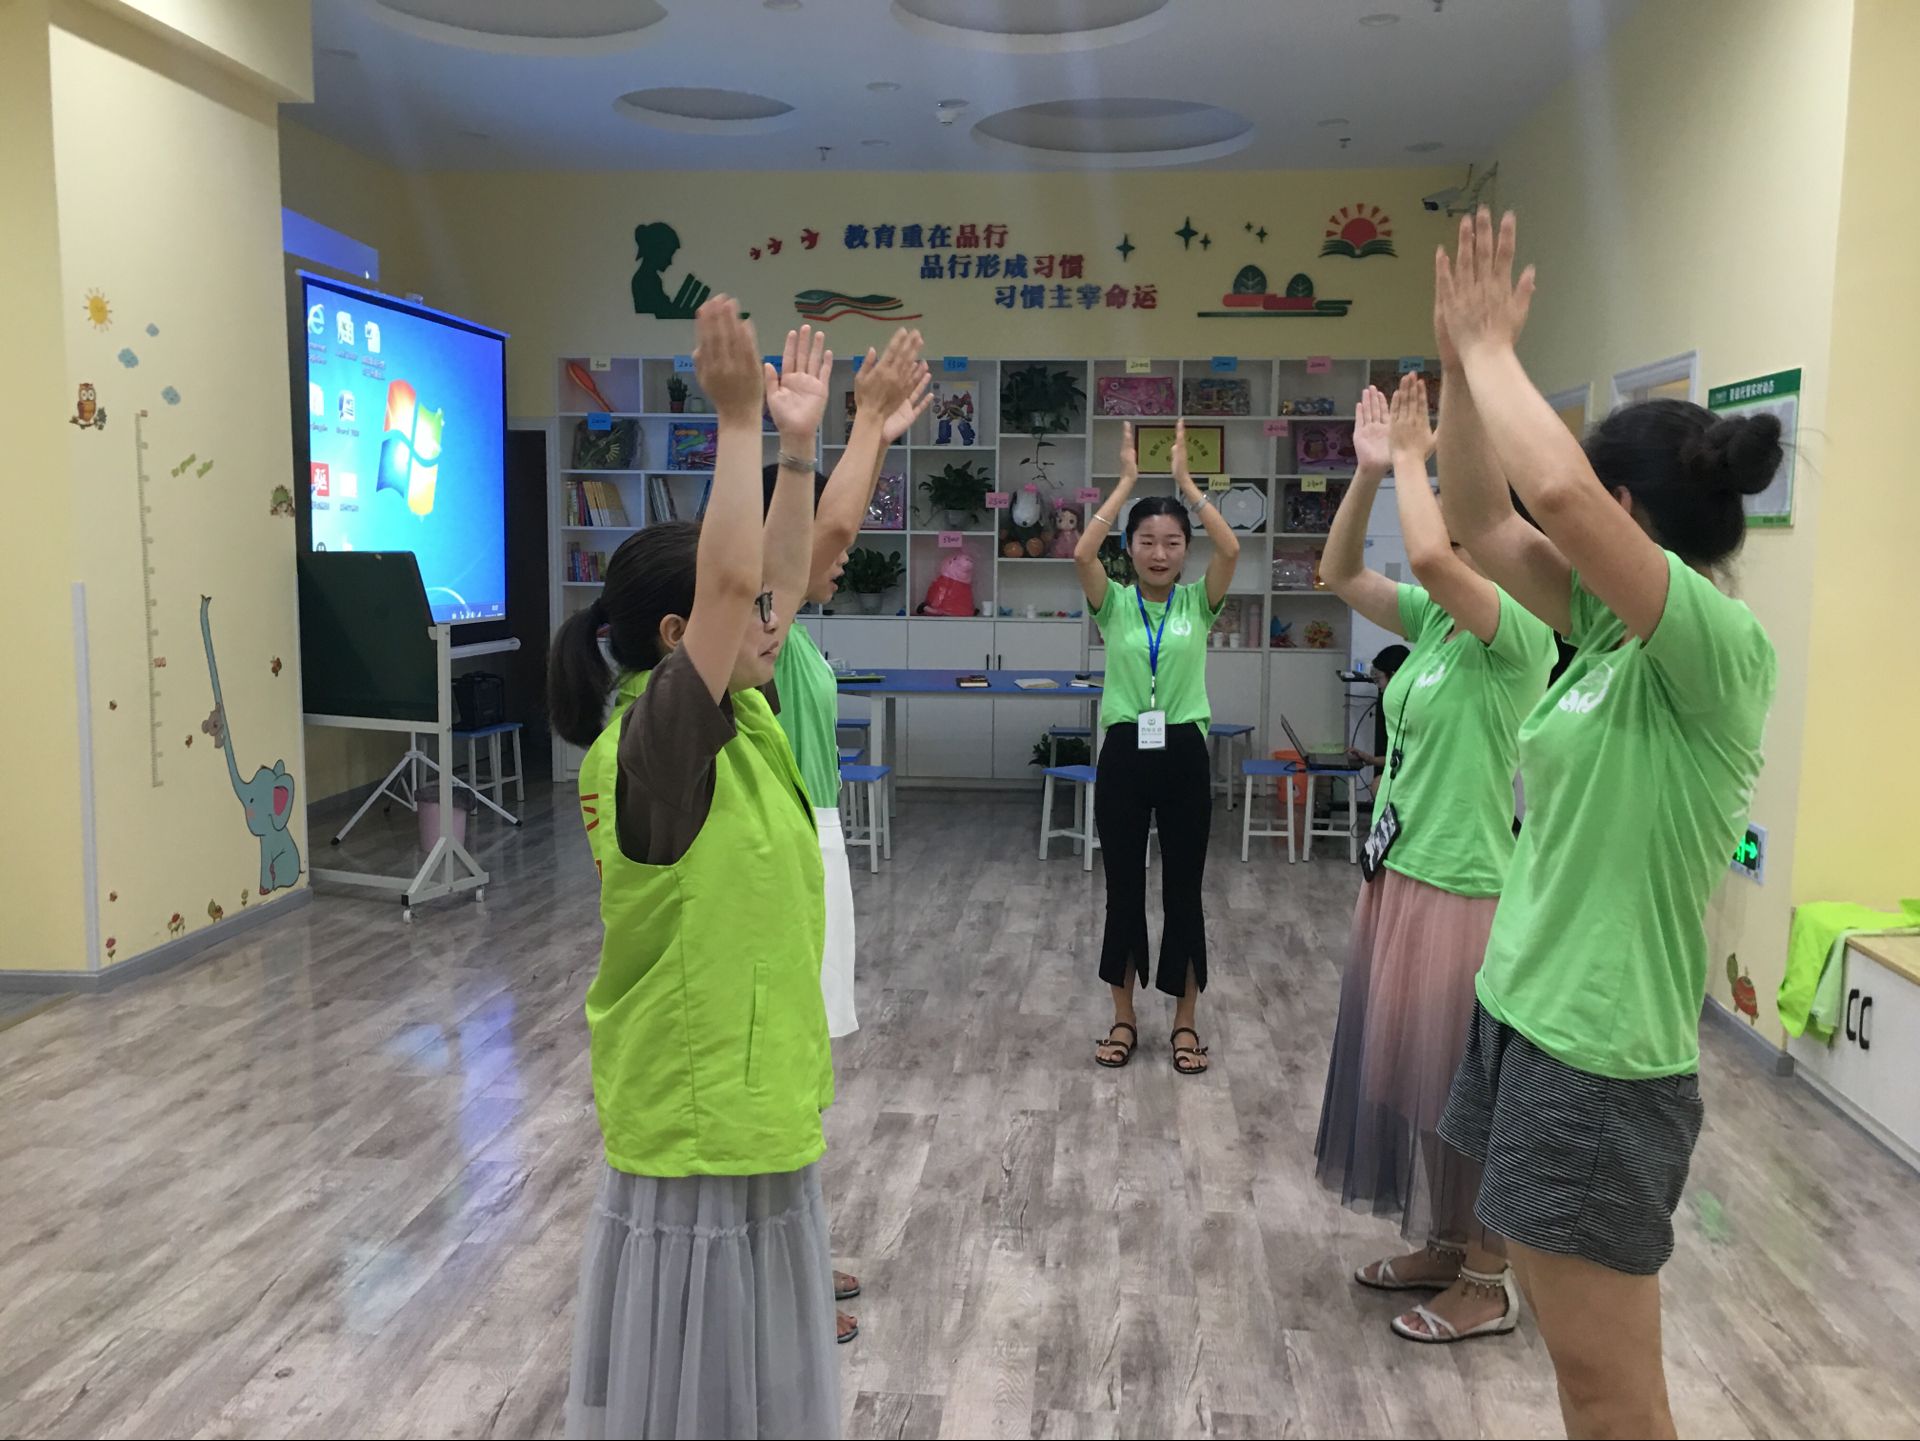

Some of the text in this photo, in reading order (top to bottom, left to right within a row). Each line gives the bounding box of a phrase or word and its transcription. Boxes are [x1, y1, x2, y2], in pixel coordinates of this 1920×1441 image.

[844, 223, 1009, 249] 教育重在品行
[919, 254, 1085, 279] 品行形成习惯
[995, 284, 1158, 310] 习惯主宰命运
